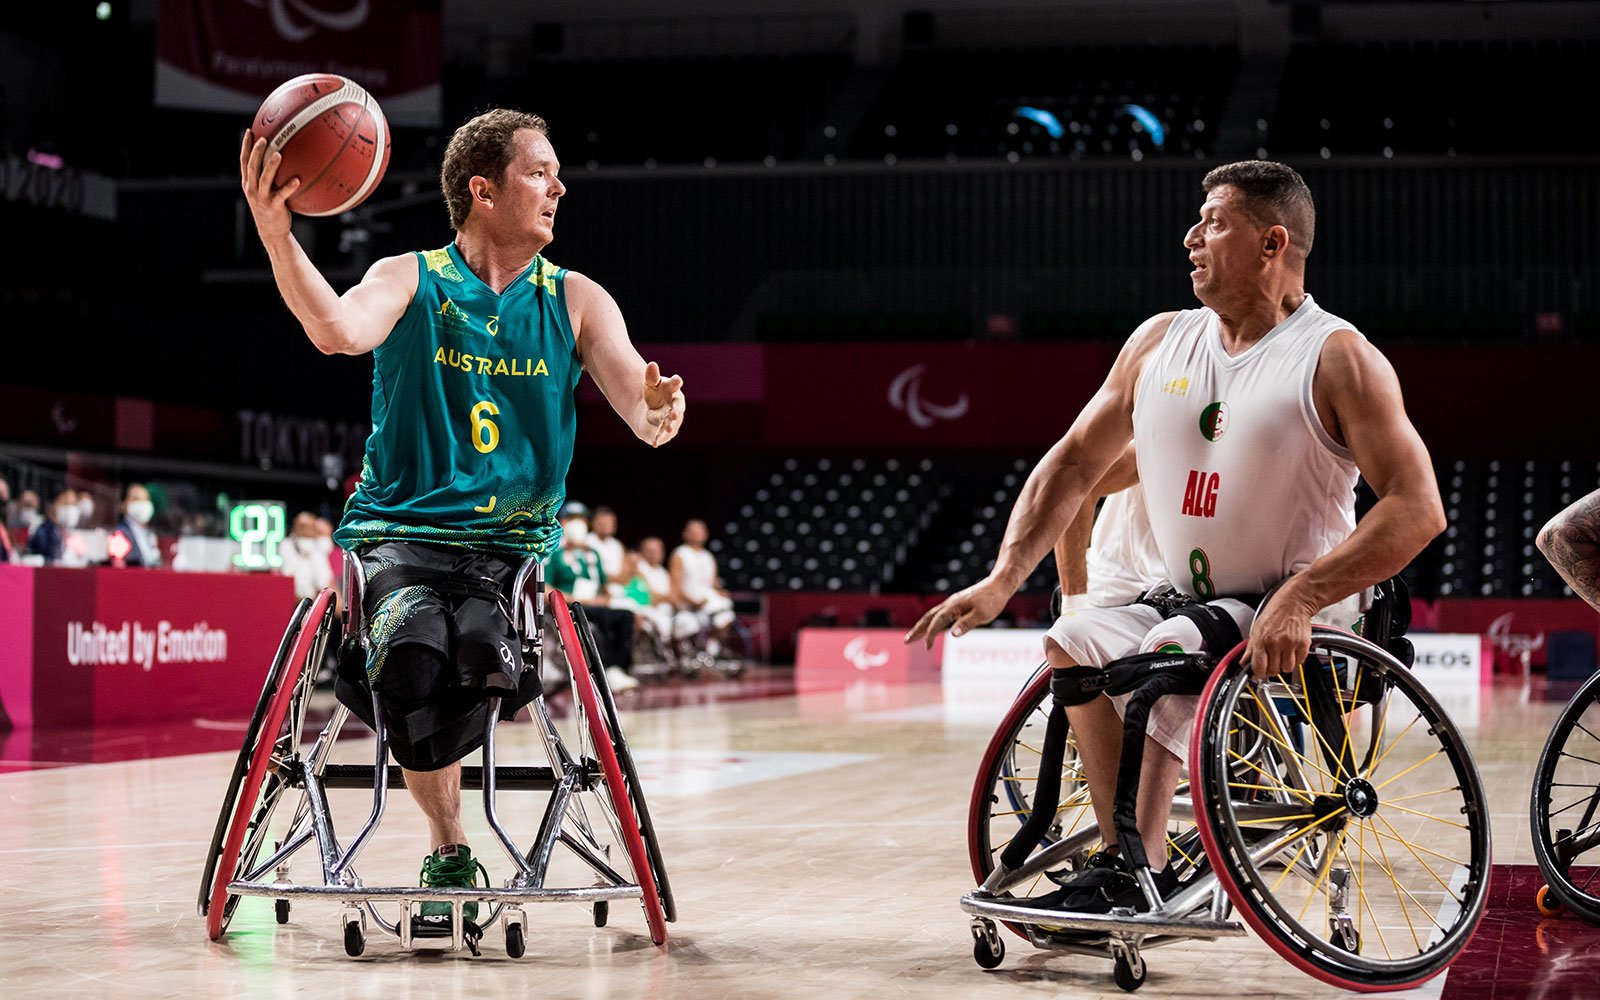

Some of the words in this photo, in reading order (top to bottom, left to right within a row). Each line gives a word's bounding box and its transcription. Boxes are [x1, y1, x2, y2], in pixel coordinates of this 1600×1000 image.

[434, 347, 549, 376] AUSTRALIA
[236, 409, 332, 469] TOKYO
[470, 400, 500, 454] 6
[1182, 470, 1220, 518] ALG
[1189, 547, 1216, 600] 8
[67, 620, 130, 666] United
[133, 620, 155, 672] by
[157, 620, 228, 664] Emotion
